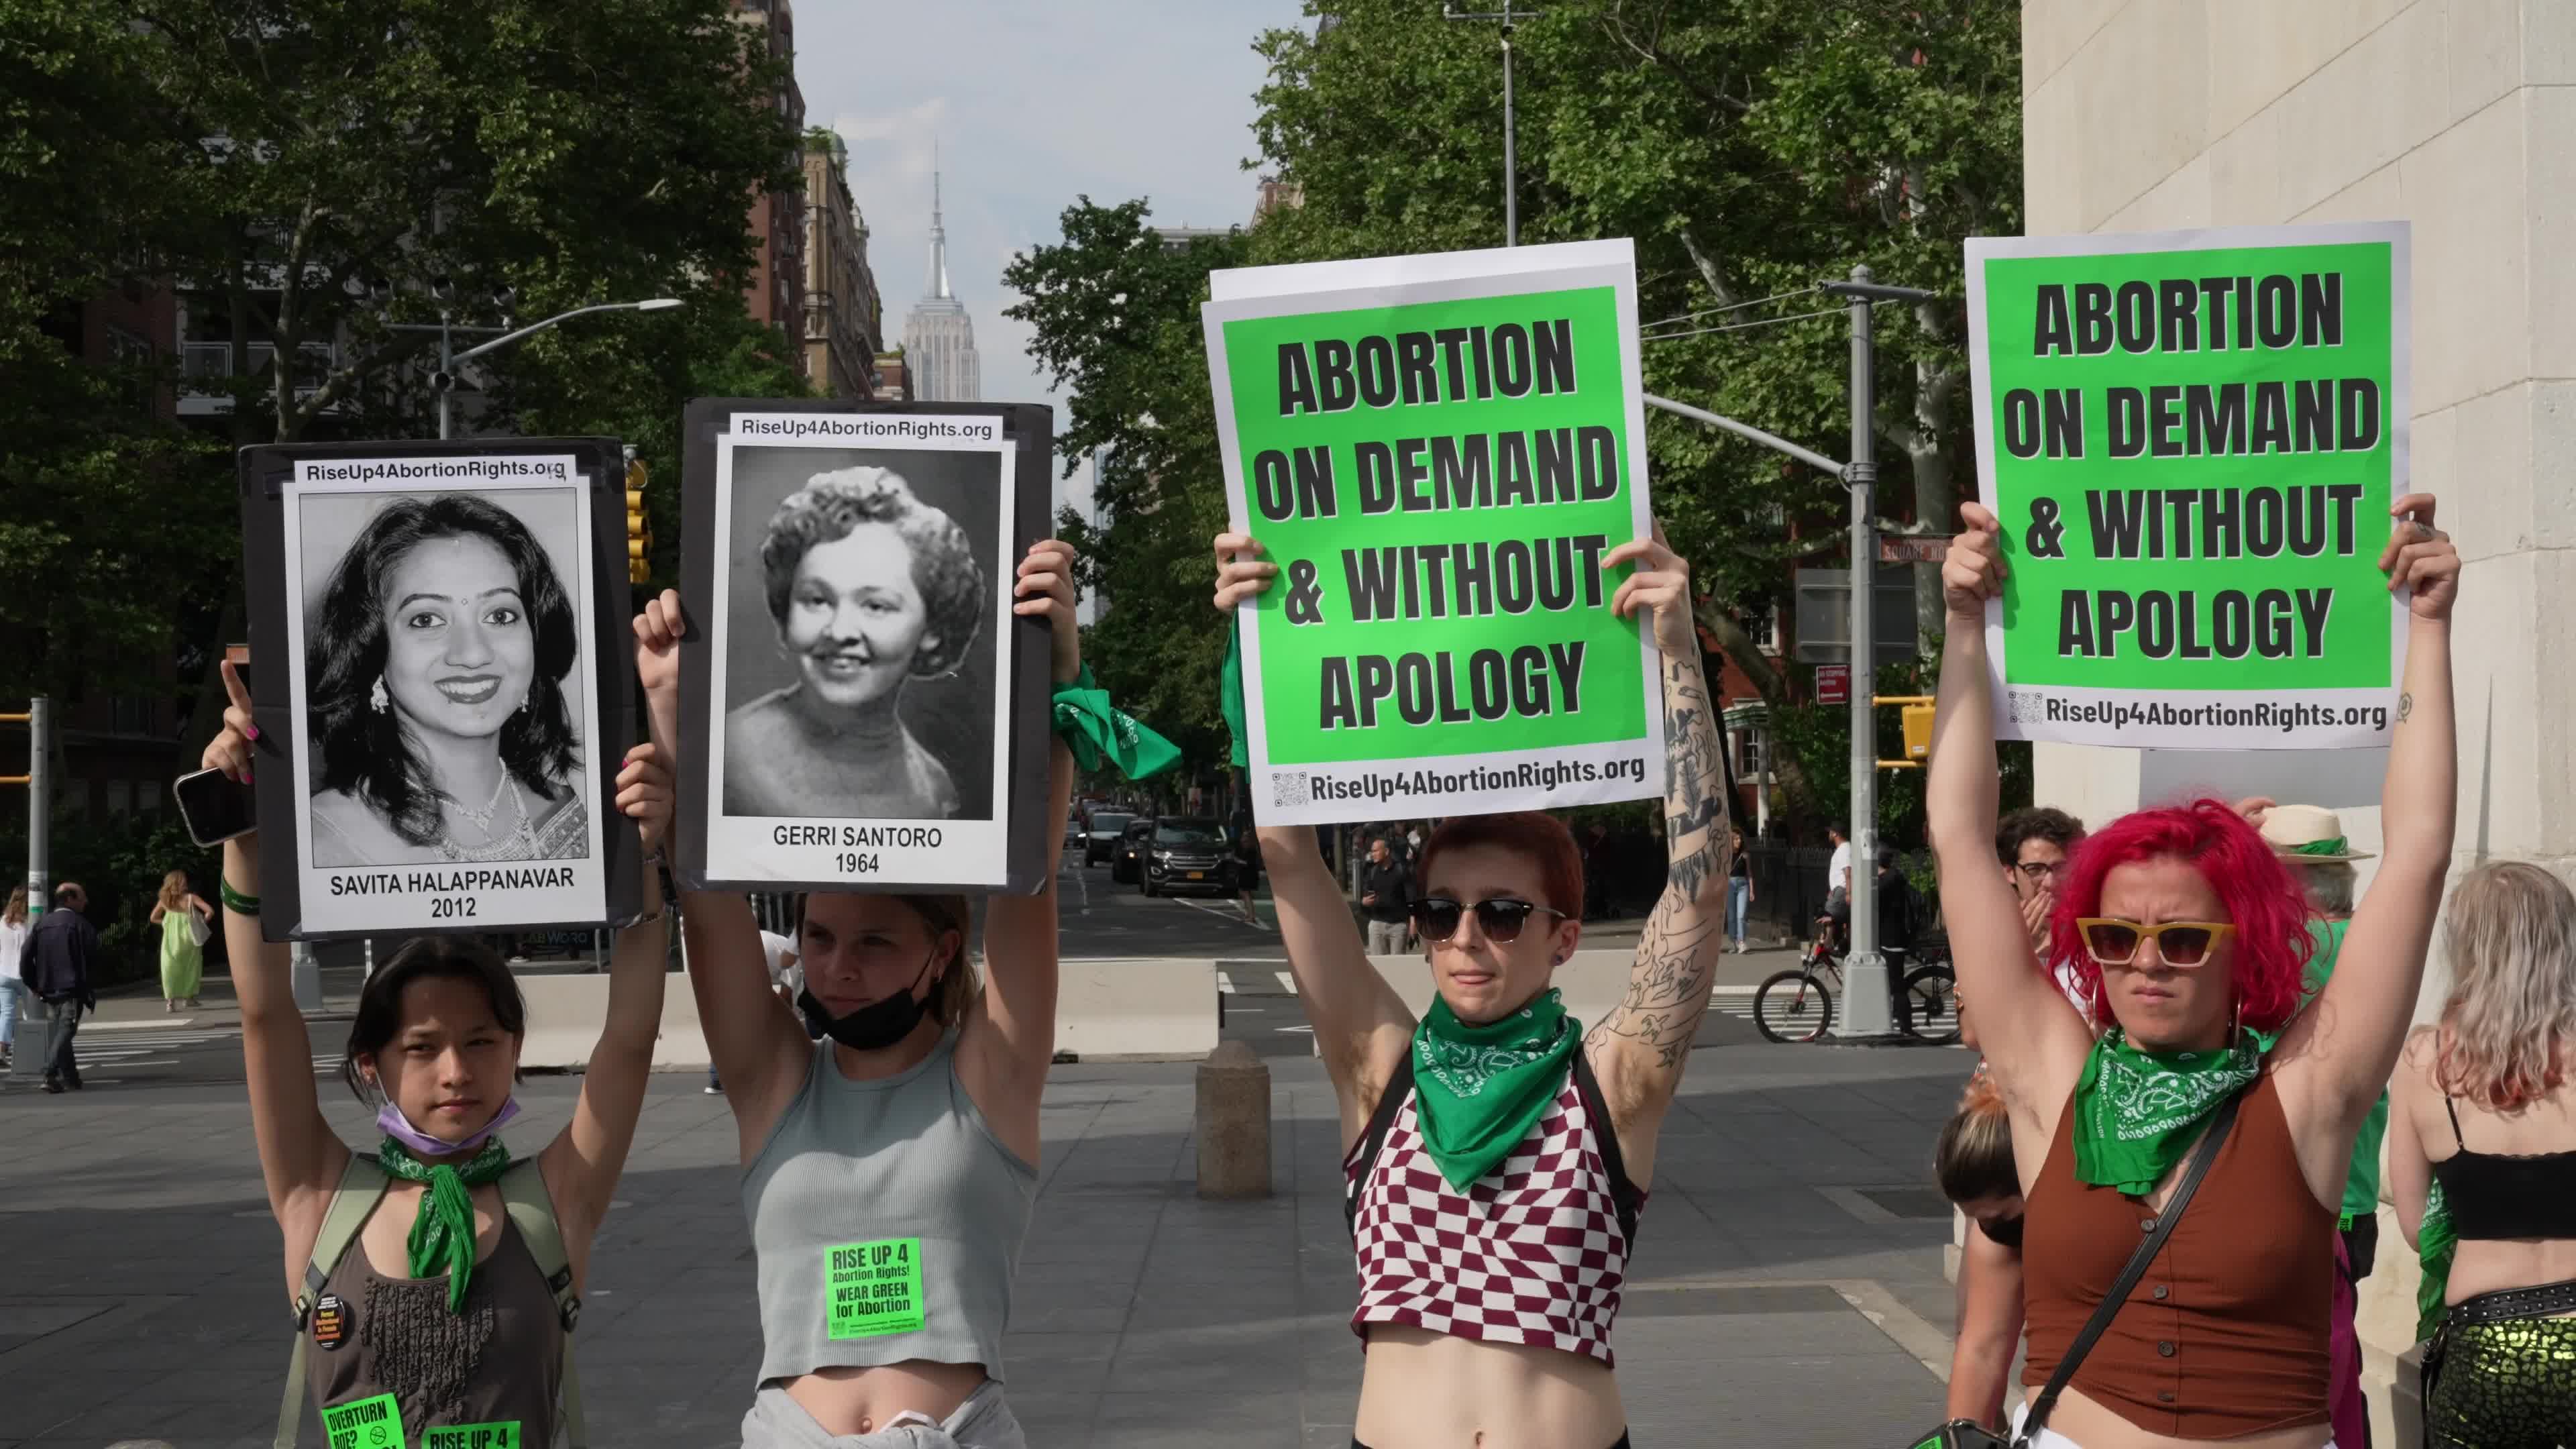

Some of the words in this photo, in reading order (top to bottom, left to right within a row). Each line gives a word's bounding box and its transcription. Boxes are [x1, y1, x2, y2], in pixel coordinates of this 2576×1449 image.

[2034, 273, 2342, 357] ABORTION
[1278, 319, 1576, 416] ABORTION
[743, 419, 992, 439] RiseUp4AbortionRights.org
[2003, 388, 2083, 460] ON
[2107, 378, 2380, 460] DEMAND
[307, 461, 566, 482] RiseUp4AbortionRights.org
[1254, 445, 1337, 521] ON
[1355, 425, 1619, 515] DEMAND
[2025, 497, 2066, 559] &
[2086, 484, 2363, 559] WITHOUT
[1285, 559, 1324, 626] &
[1341, 535, 1608, 623] WITHOUT
[2059, 588, 2334, 660] APOLOGY
[1320, 641, 1586, 731] APOLOGY
[2047, 698, 2387, 732] RiseUp4AbortionRights.org
[1310, 756, 1645, 803] RiseUp4AbortionRights.org
[773, 826, 835, 845] GERRI
[843, 827, 942, 847] SANTORO
[836, 853, 879, 873] 1964
[331, 874, 402, 896] SAVITA
[409, 868, 574, 893] HALAPPANAVAR
[431, 897, 476, 918] 2012
[833, 1248, 866, 1270] RISE
[871, 1245, 892, 1266] UP
[898, 1244, 908, 1263] 4
[833, 1269, 873, 1283] Abortion
[876, 1265, 910, 1279] Rights!
[837, 1285, 869, 1302] WEAR
[873, 1282, 908, 1298] GREEN
[836, 1303, 853, 1318] for
[858, 1298, 910, 1316] Abortion
[328, 1401, 388, 1432] OVERTURN
[430, 1432, 465, 1449] RISE
[471, 1430, 492, 1449] UP
[497, 1428, 508, 1448] 4
